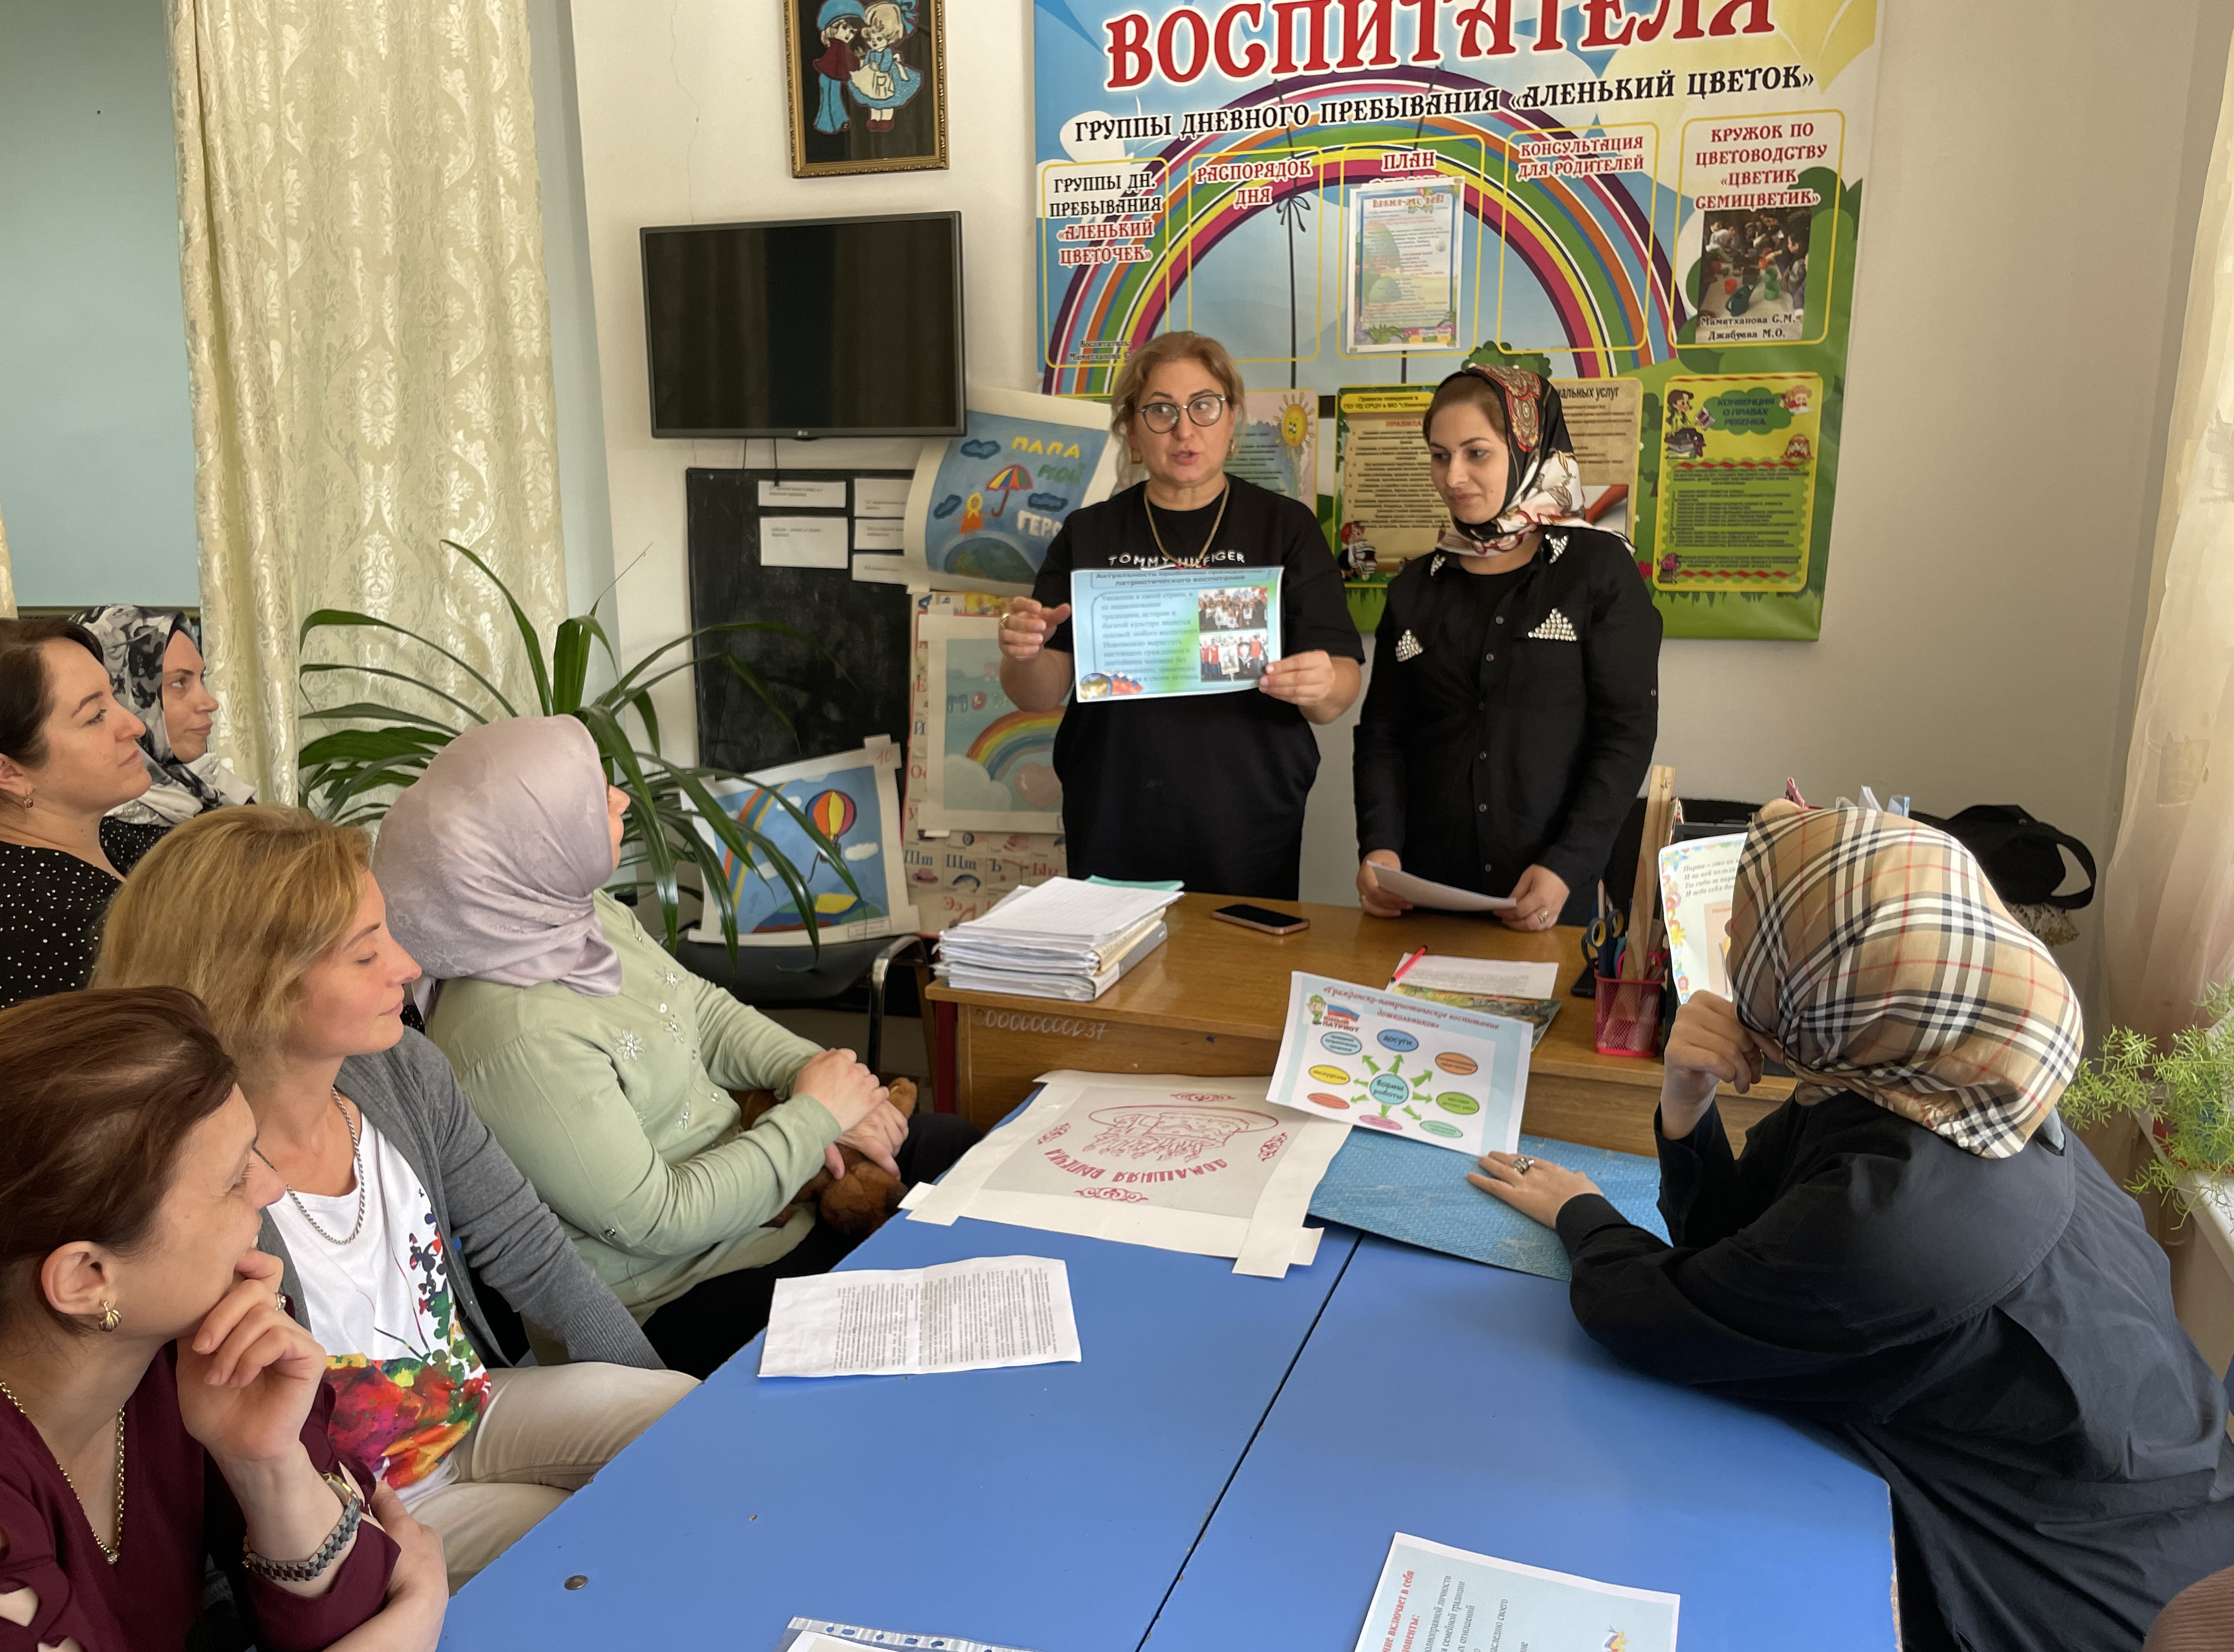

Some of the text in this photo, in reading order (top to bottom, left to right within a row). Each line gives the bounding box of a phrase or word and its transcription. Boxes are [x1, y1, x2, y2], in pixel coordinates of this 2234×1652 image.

[1075, 65, 1814, 142] ГРУППЫ ДНЕВНОГО ПРЕБЫВАНИЯ «АЛЕНЬКИЙ ЦВЕТОК»
[1711, 123, 1814, 143] КРУЖОК ПО
[1522, 136, 1643, 157] КОНСУЛЬТАЦИЯ
[1695, 144, 1828, 168] ЦВЕТОВОДСТВУ
[1197, 160, 1312, 182] РАСПОРЯДОК
[1384, 151, 1435, 170] ПЛАН
[1518, 154, 1643, 180] ДЛЯ РОДИТЕЛЕЙ
[1054, 172, 1156, 194] ГРУППЫ ДН.
[1721, 169, 1797, 189] «ЦВЕТИК
[1050, 196, 1162, 218] ПРЕБЫВАНИЯ
[1235, 188, 1272, 209] ДНЯ
[1695, 190, 1820, 210] СЕМИЦВЕТИК»
[1058, 218, 1153, 240] «АЛЕНЬКИЙ
[1060, 246, 1152, 265] ЦВЕТОЧЕК»
[1558, 387, 1620, 401] альных услуг
[1011, 436, 1081, 459] ПАПА
[1108, 550, 1246, 568] TOMMY HILFIGER
[1112, 1157, 1228, 1185] ДОМАШНЯЯ
[1438, 1575, 1452, 1607] личности
[1387, 1595, 1407, 1636] включает
[1402, 1570, 1416, 1588] себя
[1497, 1599, 1509, 1621] своего
[1442, 1611, 1458, 1648] семейной
[1452, 1581, 1465, 1613] традиции
[1460, 1604, 1475, 1644] отношений
